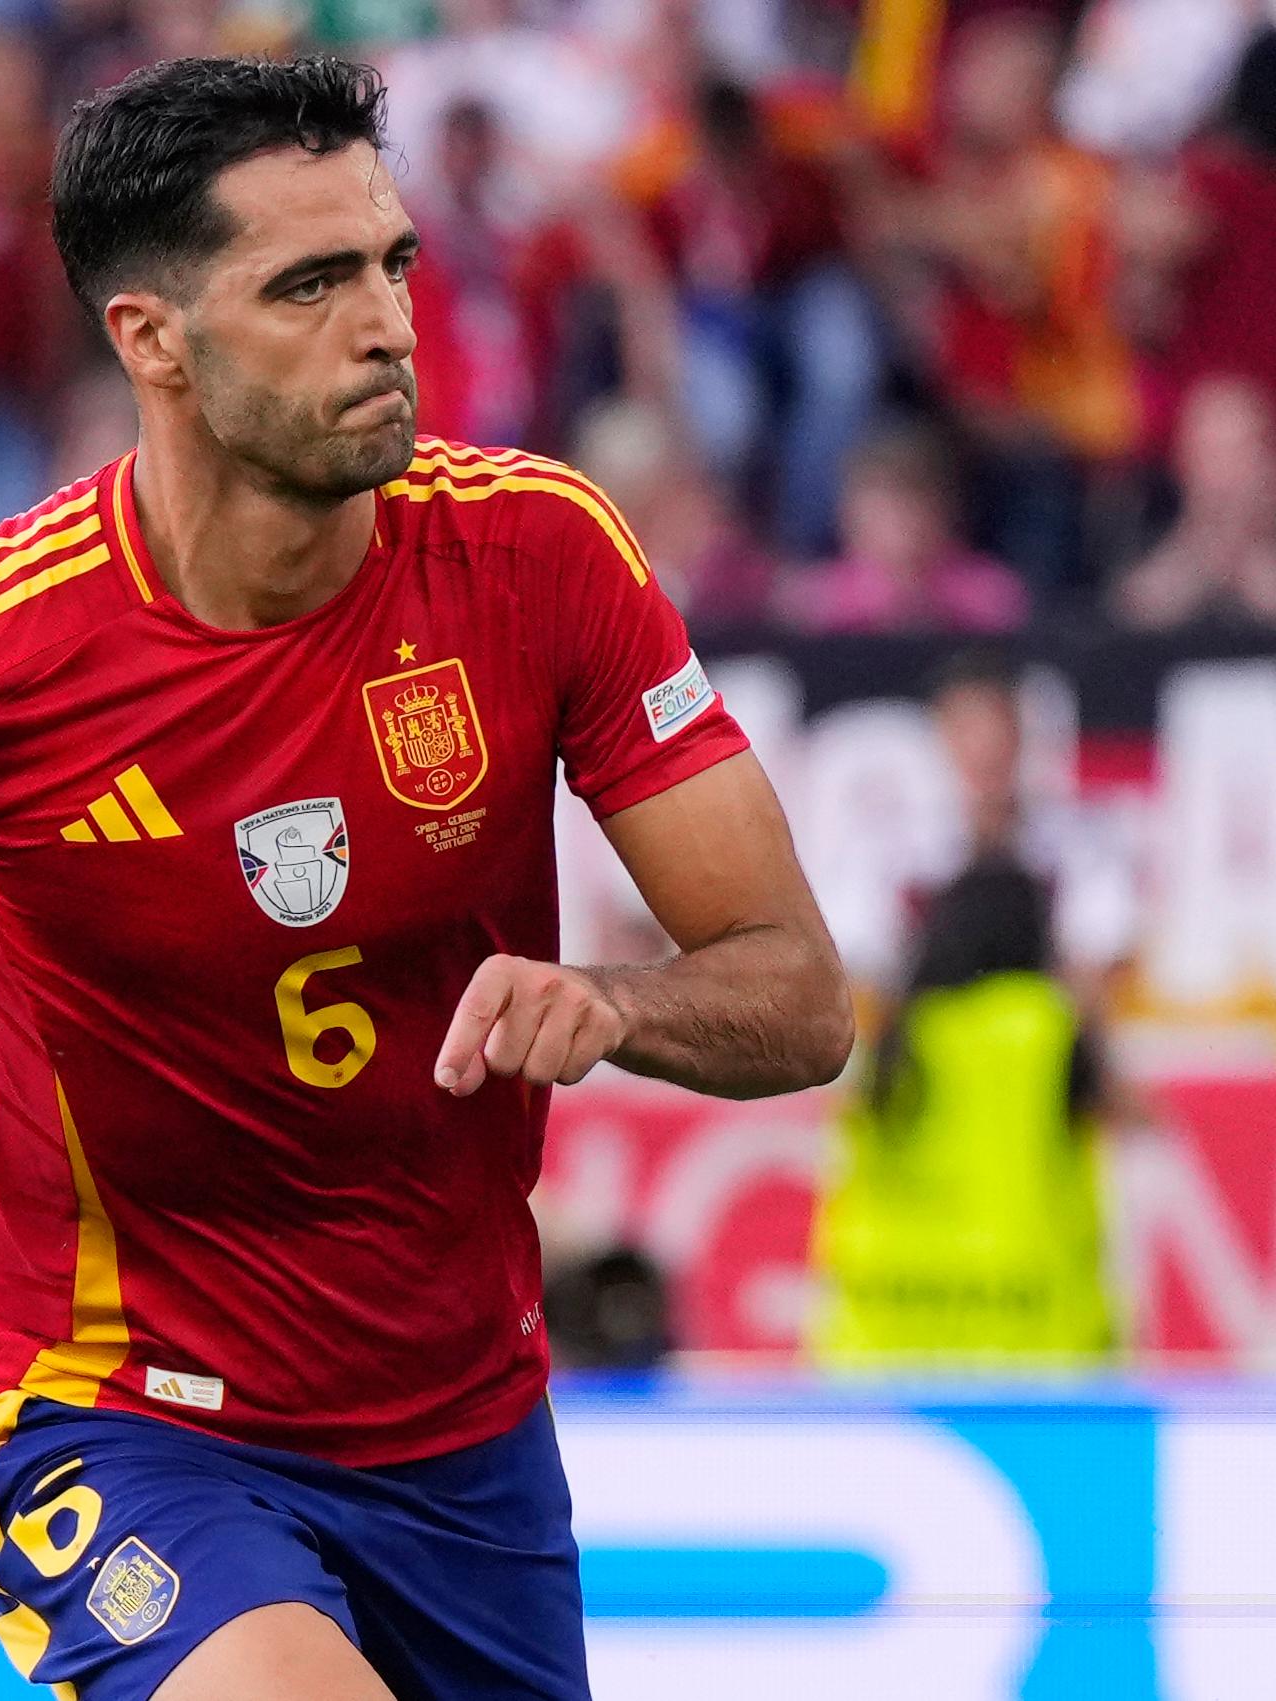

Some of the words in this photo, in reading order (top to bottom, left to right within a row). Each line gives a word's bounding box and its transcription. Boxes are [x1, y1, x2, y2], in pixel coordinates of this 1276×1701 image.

[649, 684, 674, 705] UEFA
[240, 817, 262, 831] UEFA
[262, 805, 300, 821] NATIONS
[301, 801, 335, 811] LEAGUE
[414, 821, 439, 836] SPAIN
[447, 807, 487, 826] GERMANY
[425, 833, 438, 843] 05
[439, 827, 457, 841] JULY
[432, 832, 476, 853] STUTTGART
[278, 912, 313, 921] WINNER
[275, 945, 377, 1089] 6
[7, 1457, 103, 1578] 6
